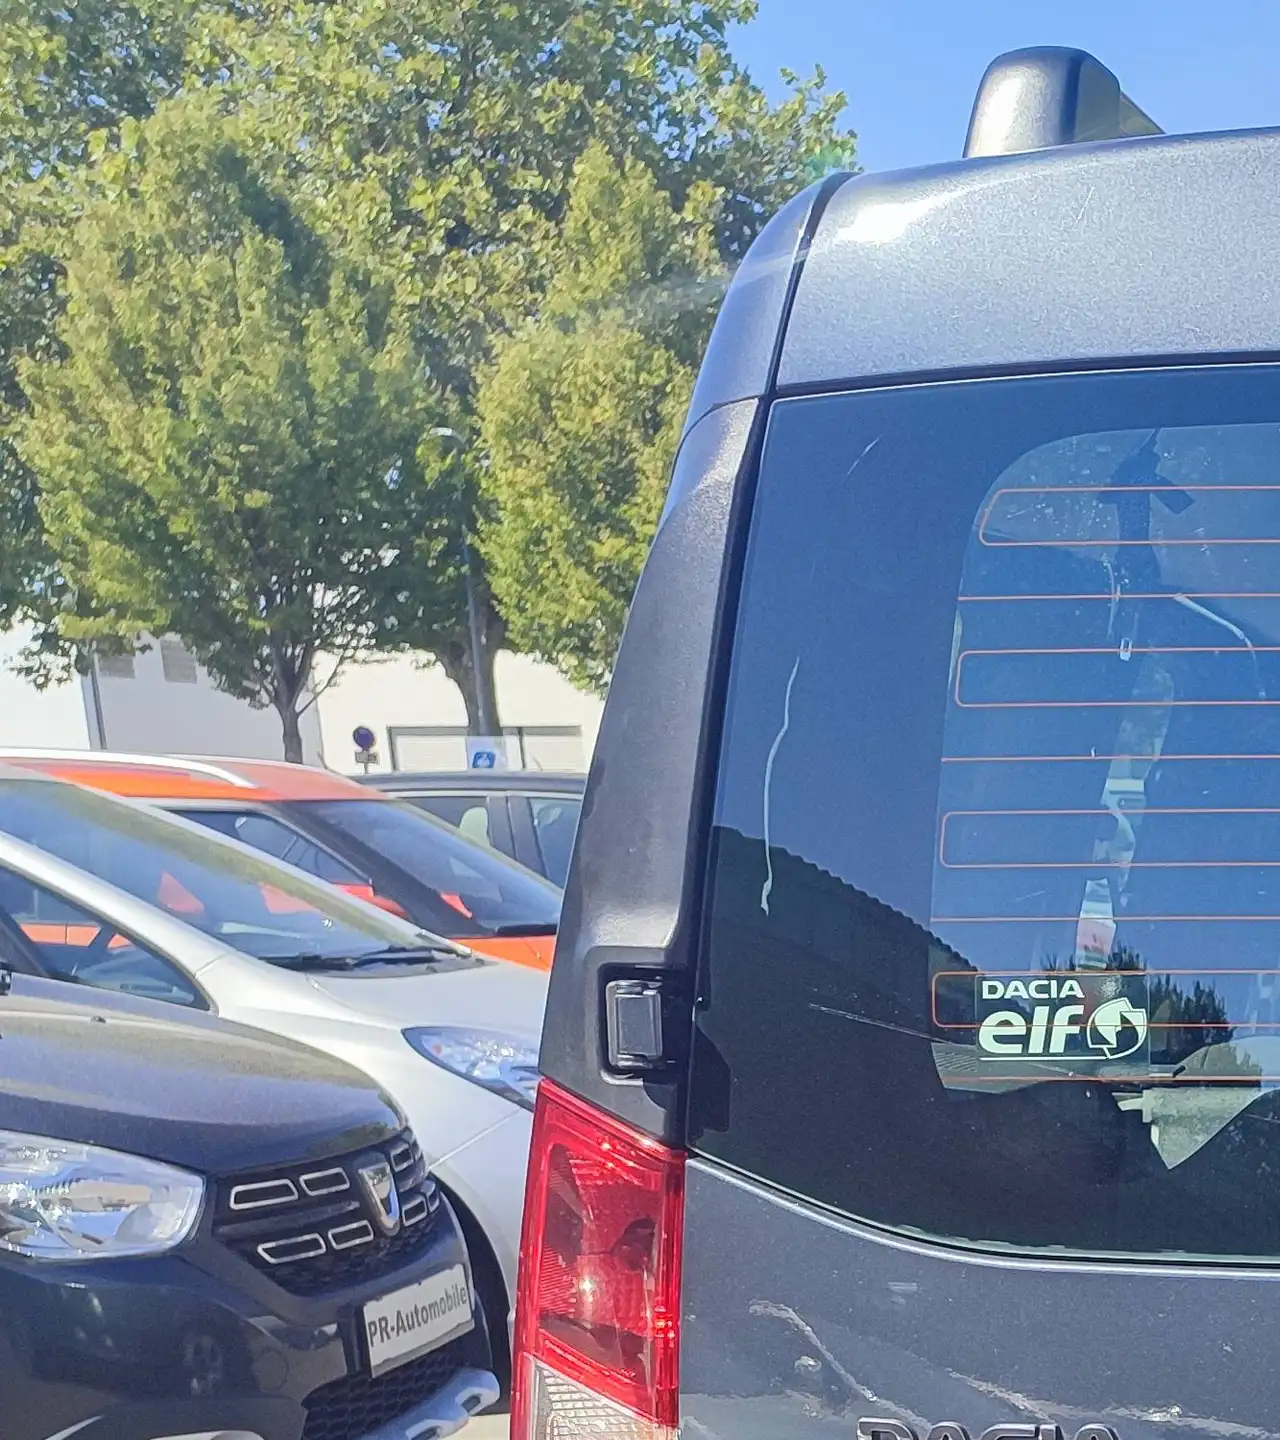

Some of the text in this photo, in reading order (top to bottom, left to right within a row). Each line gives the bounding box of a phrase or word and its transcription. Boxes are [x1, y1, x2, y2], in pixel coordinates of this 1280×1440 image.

[982, 979, 1085, 999] DACIA
[978, 1005, 1084, 1054] elf
[368, 1284, 467, 1347] PR-Automobile
